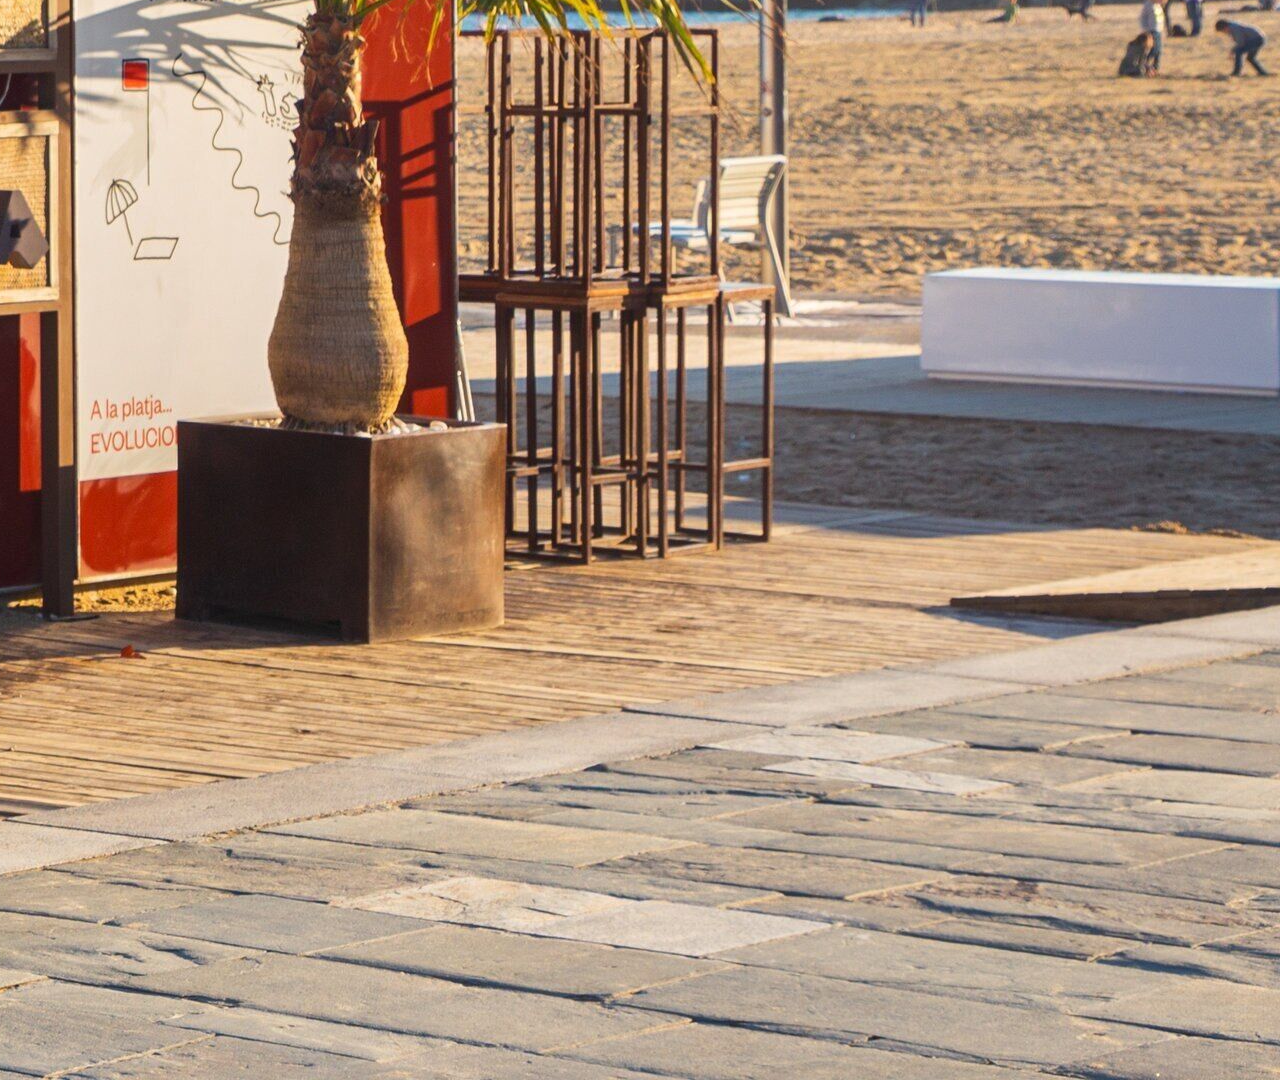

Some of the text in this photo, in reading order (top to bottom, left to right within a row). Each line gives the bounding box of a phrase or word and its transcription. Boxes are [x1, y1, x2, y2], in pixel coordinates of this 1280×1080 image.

[90, 394, 173, 421] A la platja...
[91, 426, 178, 454] EVOLUCIO
